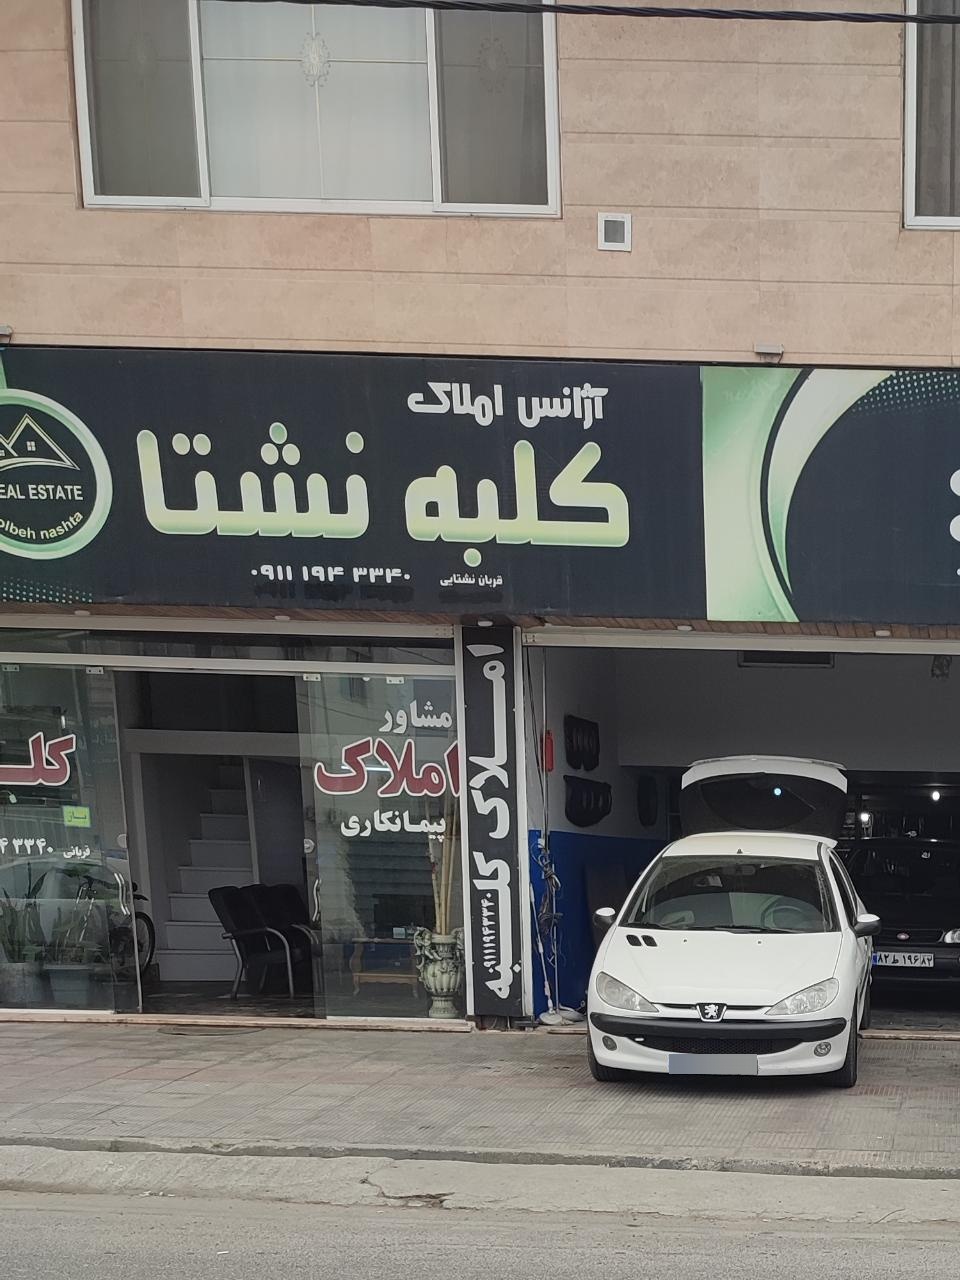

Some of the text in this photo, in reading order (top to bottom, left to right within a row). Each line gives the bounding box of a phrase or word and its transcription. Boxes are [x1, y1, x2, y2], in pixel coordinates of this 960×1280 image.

[407, 381, 609, 430] آژانس املاک
[0, 483, 84, 500] EAL ESTATE
[136, 422, 631, 568] کلبه نشتا
[0, 511, 84, 540] olbeh nashta
[251, 564, 411, 584] ۰۹۱۱ ۱۹۴ ۳۳۴۰
[478, 573, 503, 588] قربان
[378, 699, 453, 734] مشاور
[0, 731, 76, 786] کل
[314, 736, 461, 798] املاک
[466, 644, 522, 999] املاک کلبه
[63, 844, 91, 859] قربانی
